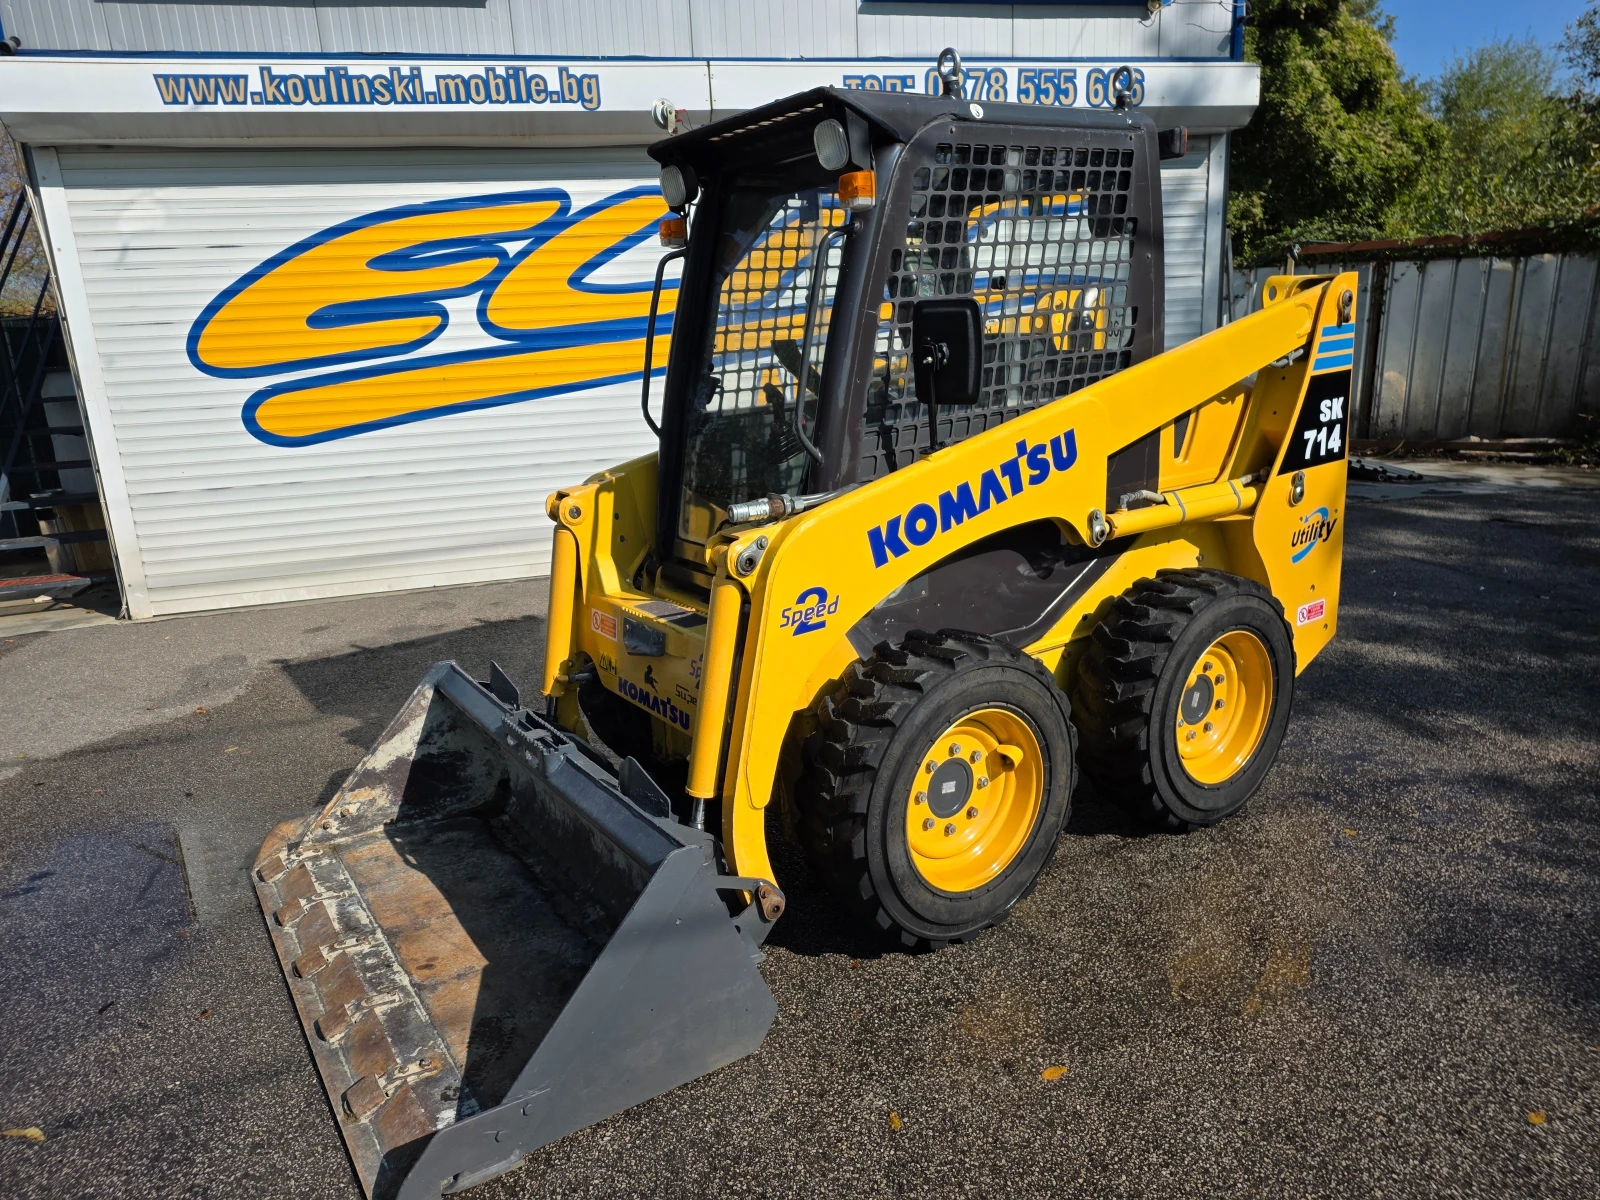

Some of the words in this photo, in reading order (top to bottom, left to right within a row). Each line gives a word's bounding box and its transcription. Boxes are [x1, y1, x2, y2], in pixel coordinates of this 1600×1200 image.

[153, 66, 601, 111] www.koulinski.mobile.bg
[1017, 68, 1077, 107] 555
[1319, 396, 1345, 423] SK
[1303, 423, 1342, 460] 714
[867, 428, 1078, 569] KOMATSU
[1291, 517, 1338, 547] Utility
[780, 594, 840, 628] Speed
[792, 586, 828, 636] 2
[618, 676, 690, 730] KOMATSU
